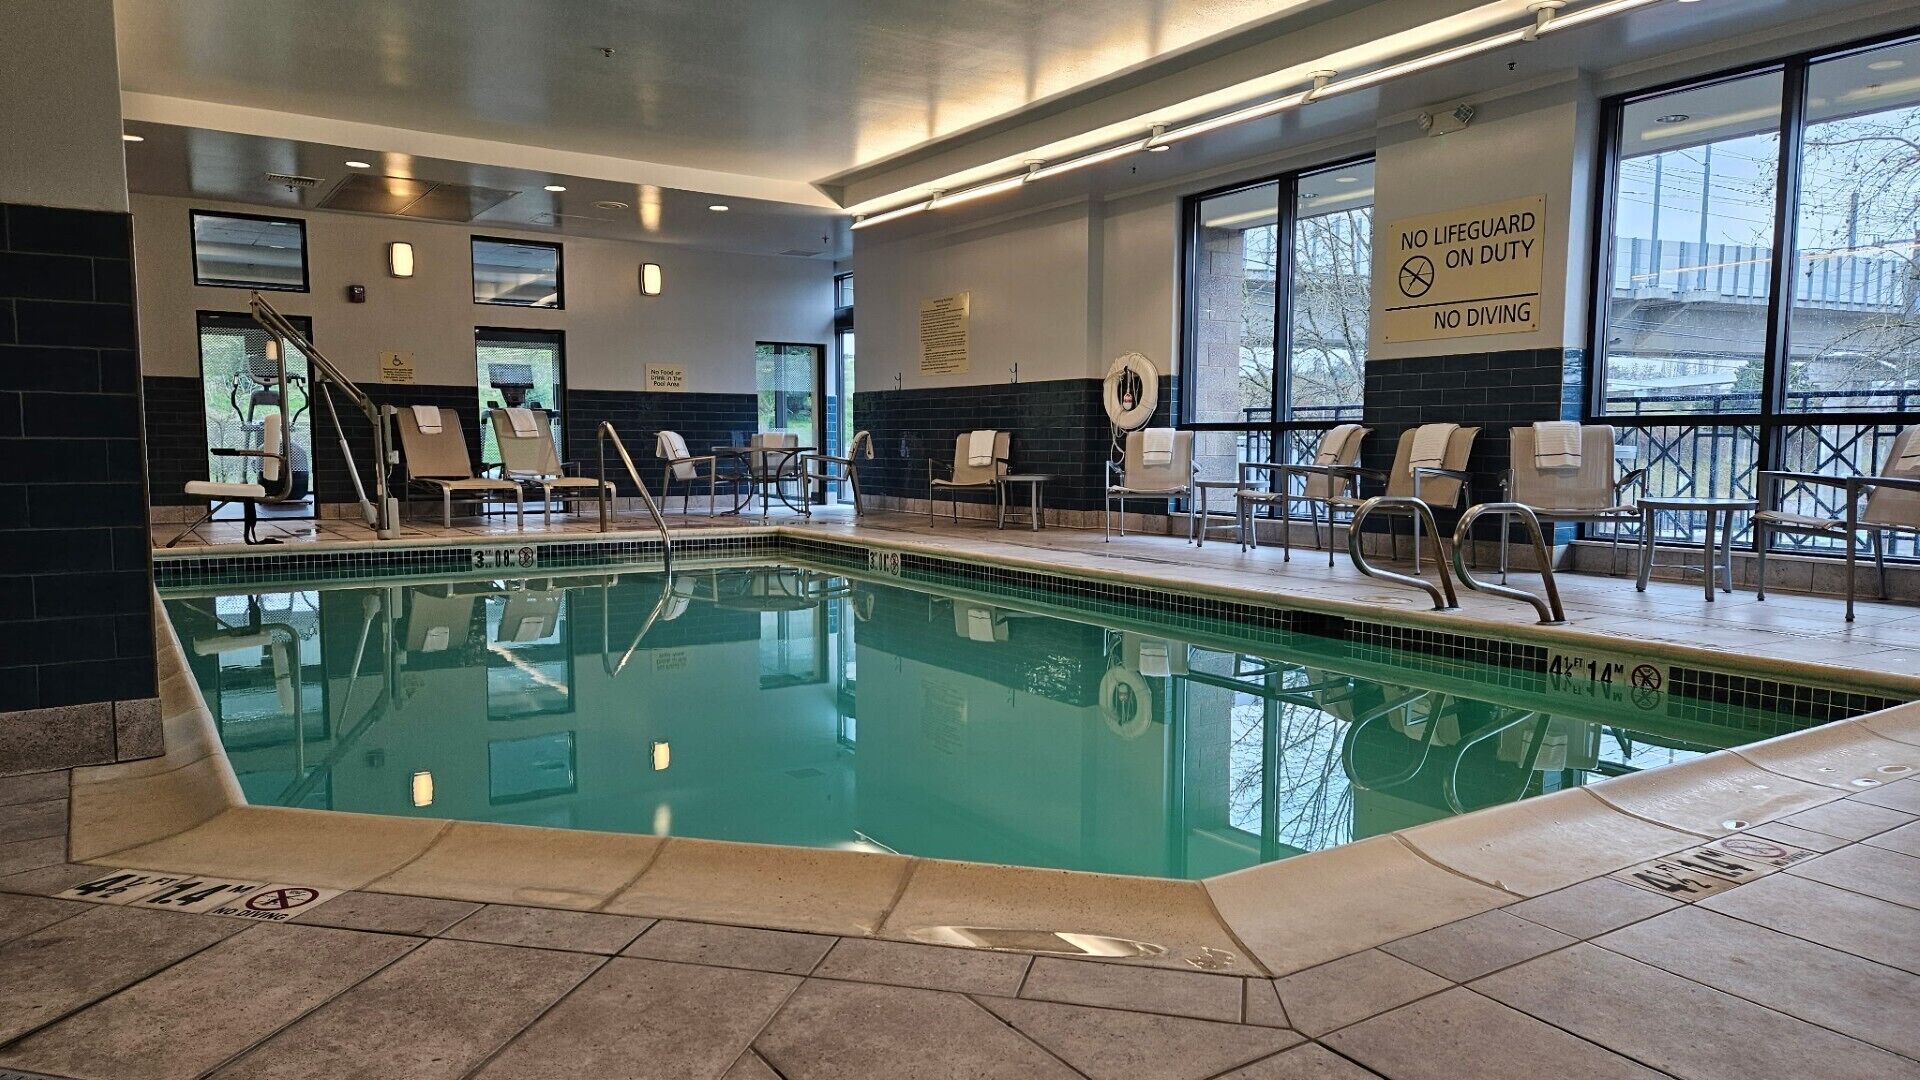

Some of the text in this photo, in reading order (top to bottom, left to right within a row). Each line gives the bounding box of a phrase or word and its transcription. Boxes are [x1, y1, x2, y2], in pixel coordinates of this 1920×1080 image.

[1401, 212, 1536, 250] NO LIFEGUARD
[1446, 238, 1535, 269] ON DUTY
[1434, 302, 1531, 330] NO DIVING
[1574, 657, 1583, 668] FT
[1614, 663, 1624, 674] M
[148, 877, 179, 886] FT
[227, 884, 256, 894] M
[146, 881, 233, 907] 1.4
[212, 907, 289, 921] NO DIVING
